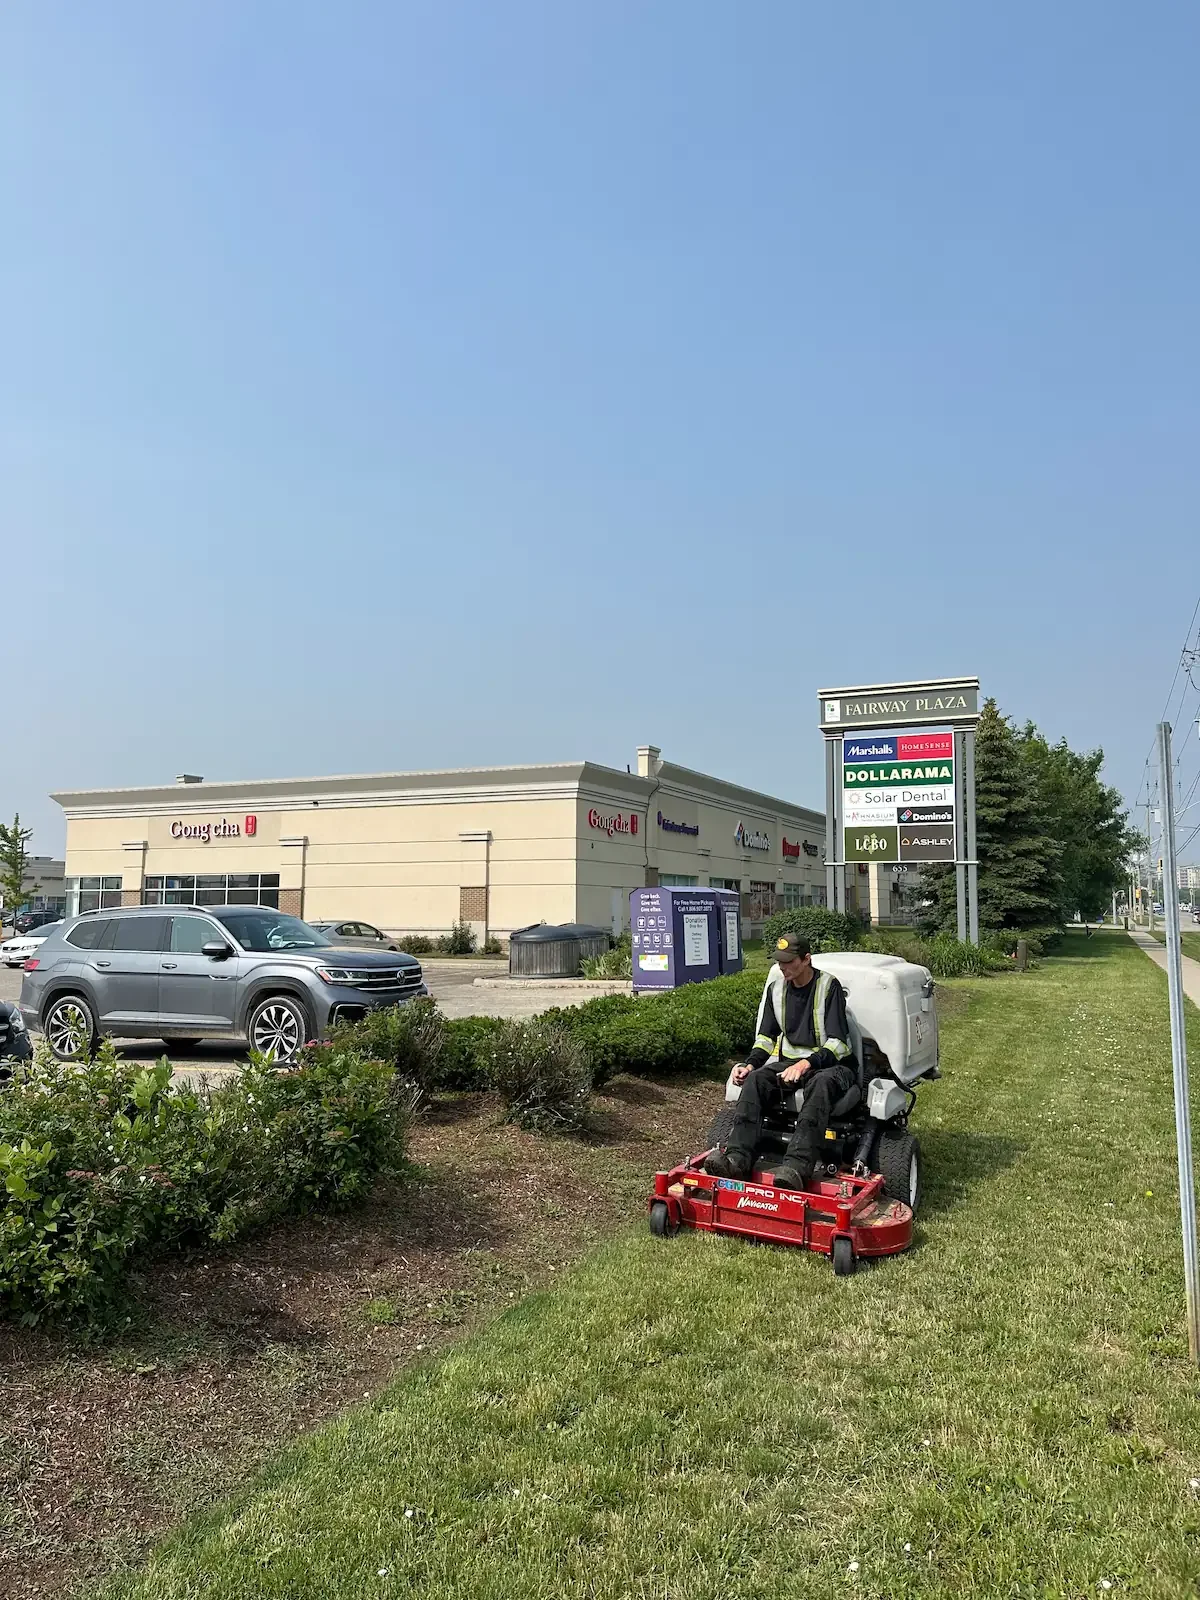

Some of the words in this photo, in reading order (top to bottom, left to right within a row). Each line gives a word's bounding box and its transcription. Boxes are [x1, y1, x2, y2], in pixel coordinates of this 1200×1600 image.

[845, 700, 910, 716] FAIRWAY
[916, 696, 967, 711] PLAZA
[848, 744, 893, 756] Marshalls
[845, 766, 952, 782] DOLLARAMA
[865, 792, 897, 804] Solar
[902, 789, 946, 802] Dental
[588, 808, 615, 836] Gong
[614, 813, 630, 833] cha
[846, 812, 894, 821] MATHNASIUM
[913, 812, 952, 821] Domino's
[169, 820, 210, 842] Gong
[212, 818, 239, 836] cha
[855, 838, 887, 850] LCBO
[912, 838, 953, 846] ASHLEY
[745, 1187, 775, 1198] PRO
[737, 1196, 778, 1212] NAVIGATOR
